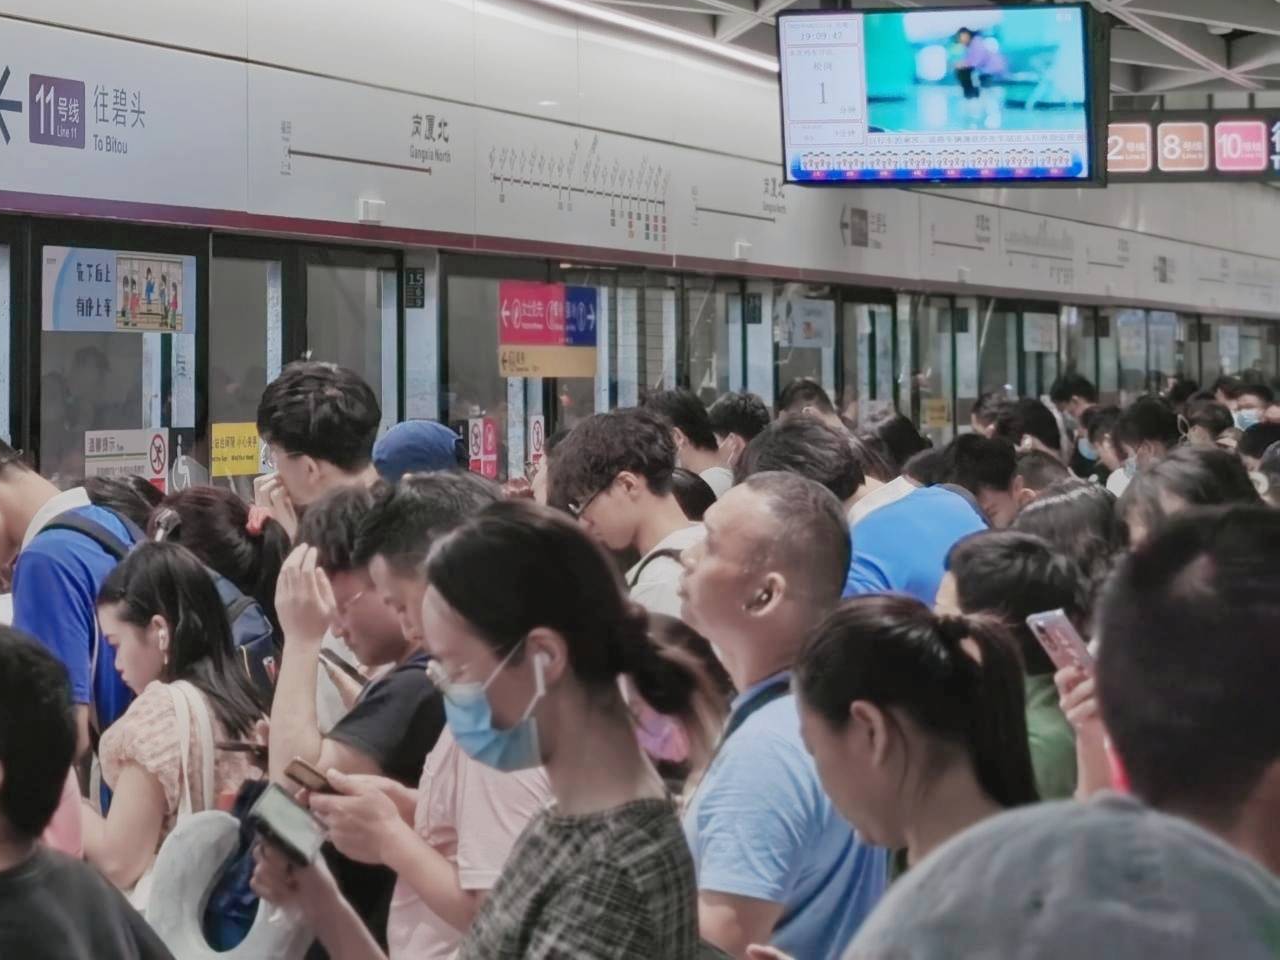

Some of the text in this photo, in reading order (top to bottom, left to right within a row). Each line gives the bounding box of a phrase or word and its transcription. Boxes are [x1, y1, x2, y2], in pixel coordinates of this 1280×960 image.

[93, 84, 147, 128] 往碧头
[56, 125, 77, 139] Line 11
[93, 134, 128, 154] To Bitou
